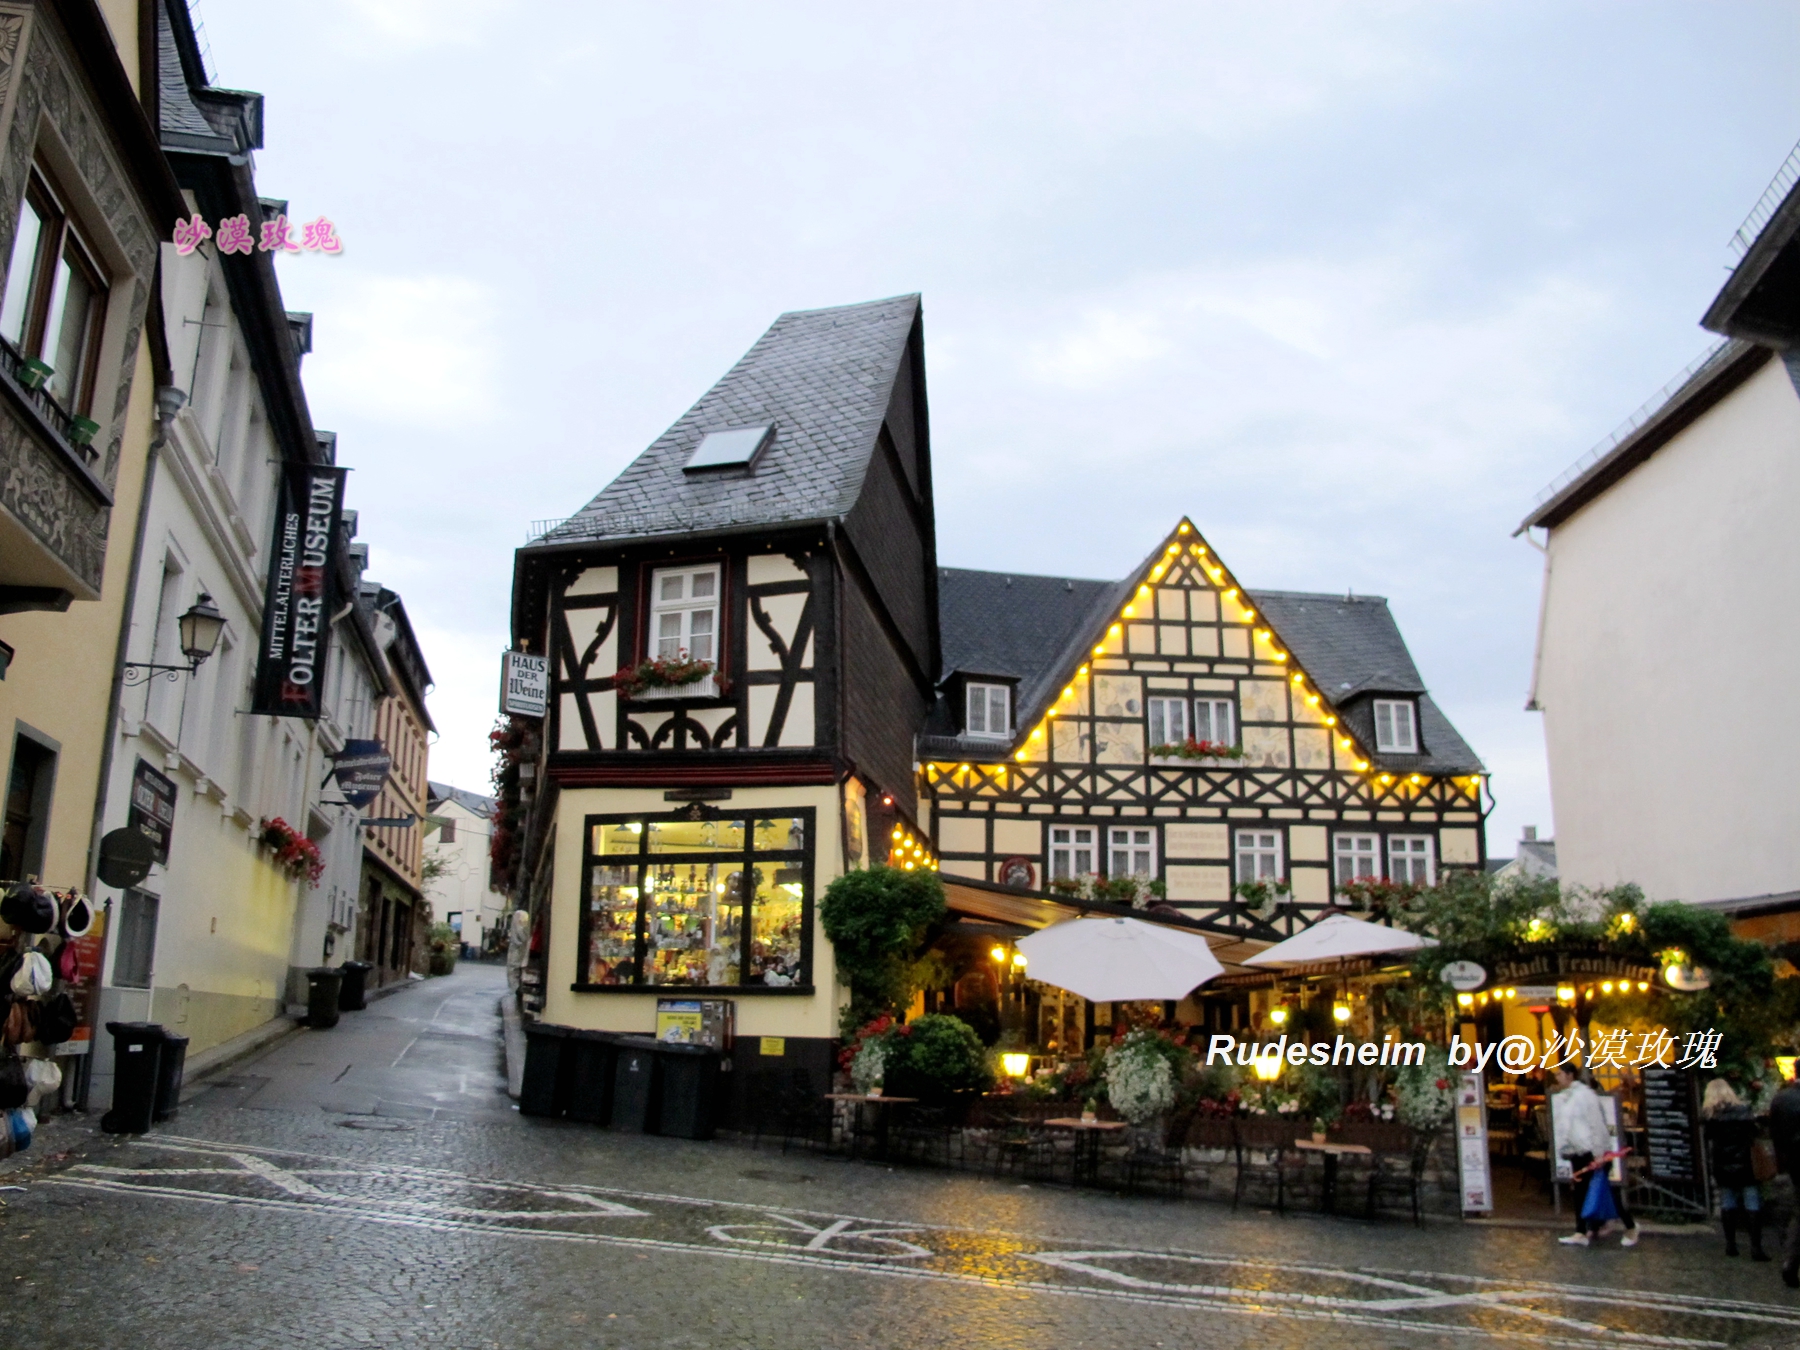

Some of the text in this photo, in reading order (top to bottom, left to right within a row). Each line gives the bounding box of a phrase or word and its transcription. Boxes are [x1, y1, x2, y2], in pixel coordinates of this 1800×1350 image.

[270, 513, 300, 660] MITTELALTERLICHES
[282, 477, 337, 703] FOLTER MUSEUM
[512, 655, 545, 672] HAUS
[517, 670, 538, 682] DER
[509, 677, 545, 700] Weine
[1495, 955, 1549, 983] Stadt
[1556, 951, 1656, 980] Frankfurt
